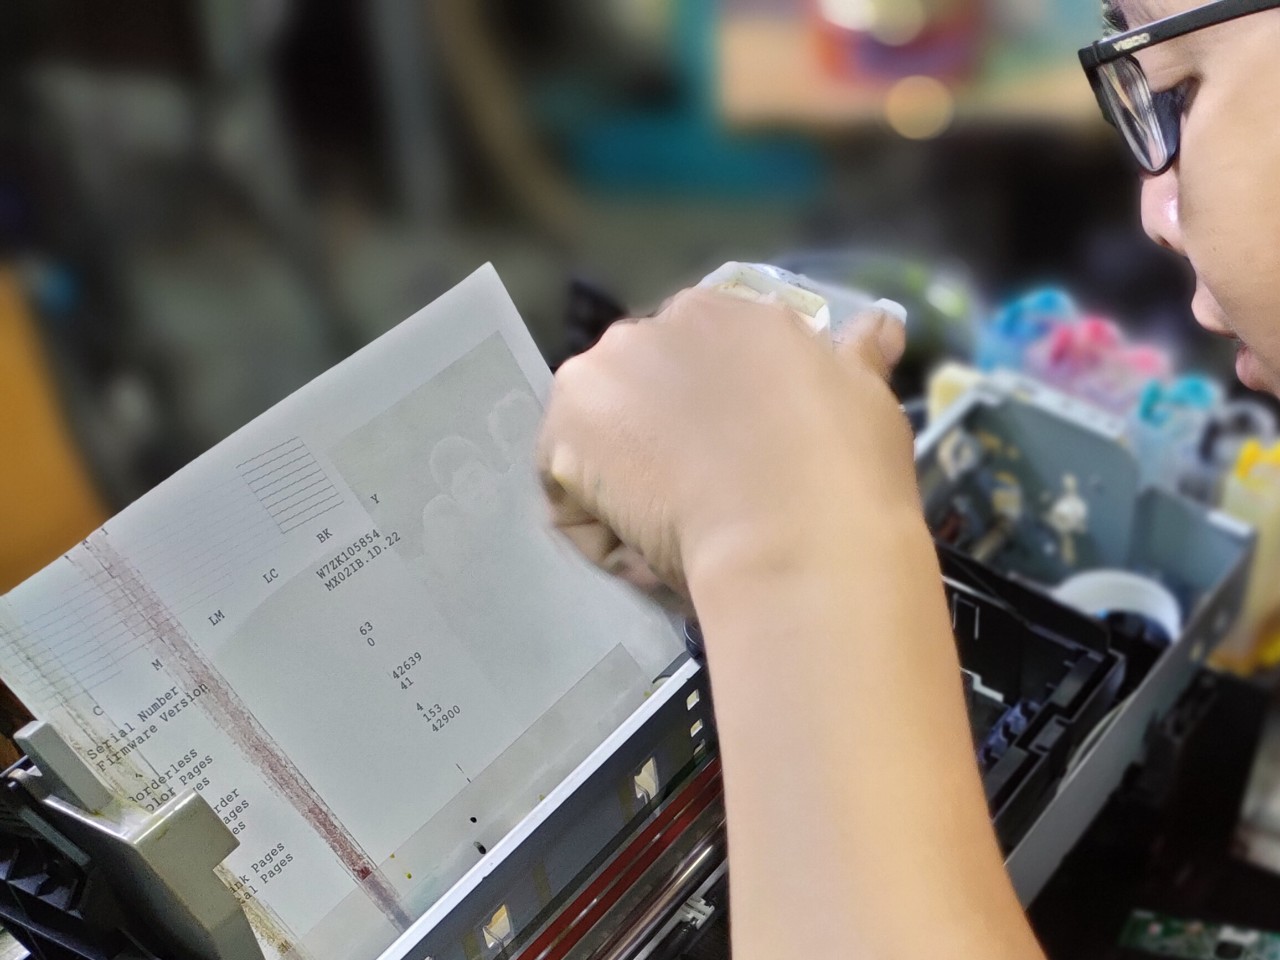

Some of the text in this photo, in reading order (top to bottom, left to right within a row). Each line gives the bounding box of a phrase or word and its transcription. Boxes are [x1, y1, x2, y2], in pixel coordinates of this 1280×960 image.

[87, 529, 380, 760] Serial Number W7ZK105854
[93, 493, 380, 716] C M LM LC BK Y
[400, 677, 414, 690] 41
[96, 724, 158, 772] Firmware
[159, 683, 209, 722] Version
[145, 786, 176, 811] olor
[179, 754, 213, 786] Pages
[359, 622, 373, 636] 63
[223, 652, 422, 825] ages 42639
[260, 705, 460, 884] Pages 42900
[416, 702, 424, 712] 4
[214, 787, 240, 814] rder
[229, 703, 442, 894] ank Pages 153
